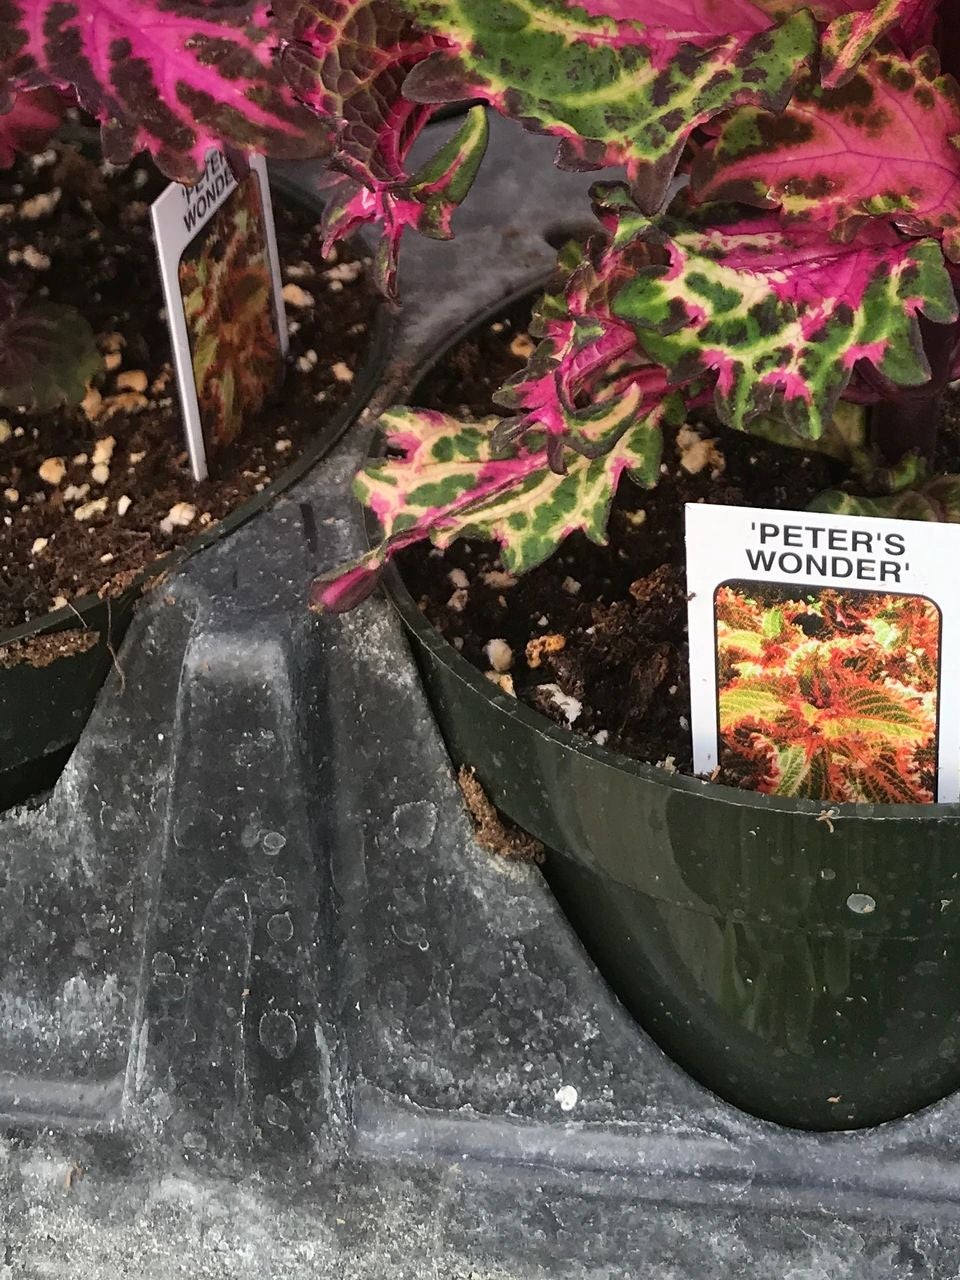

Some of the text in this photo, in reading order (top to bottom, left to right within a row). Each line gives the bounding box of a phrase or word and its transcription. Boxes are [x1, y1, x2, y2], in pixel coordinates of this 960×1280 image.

[184, 167, 234, 232] WONDE
[752, 522, 906, 556] 'PETER'S
[746, 549, 910, 583] WONDER'
